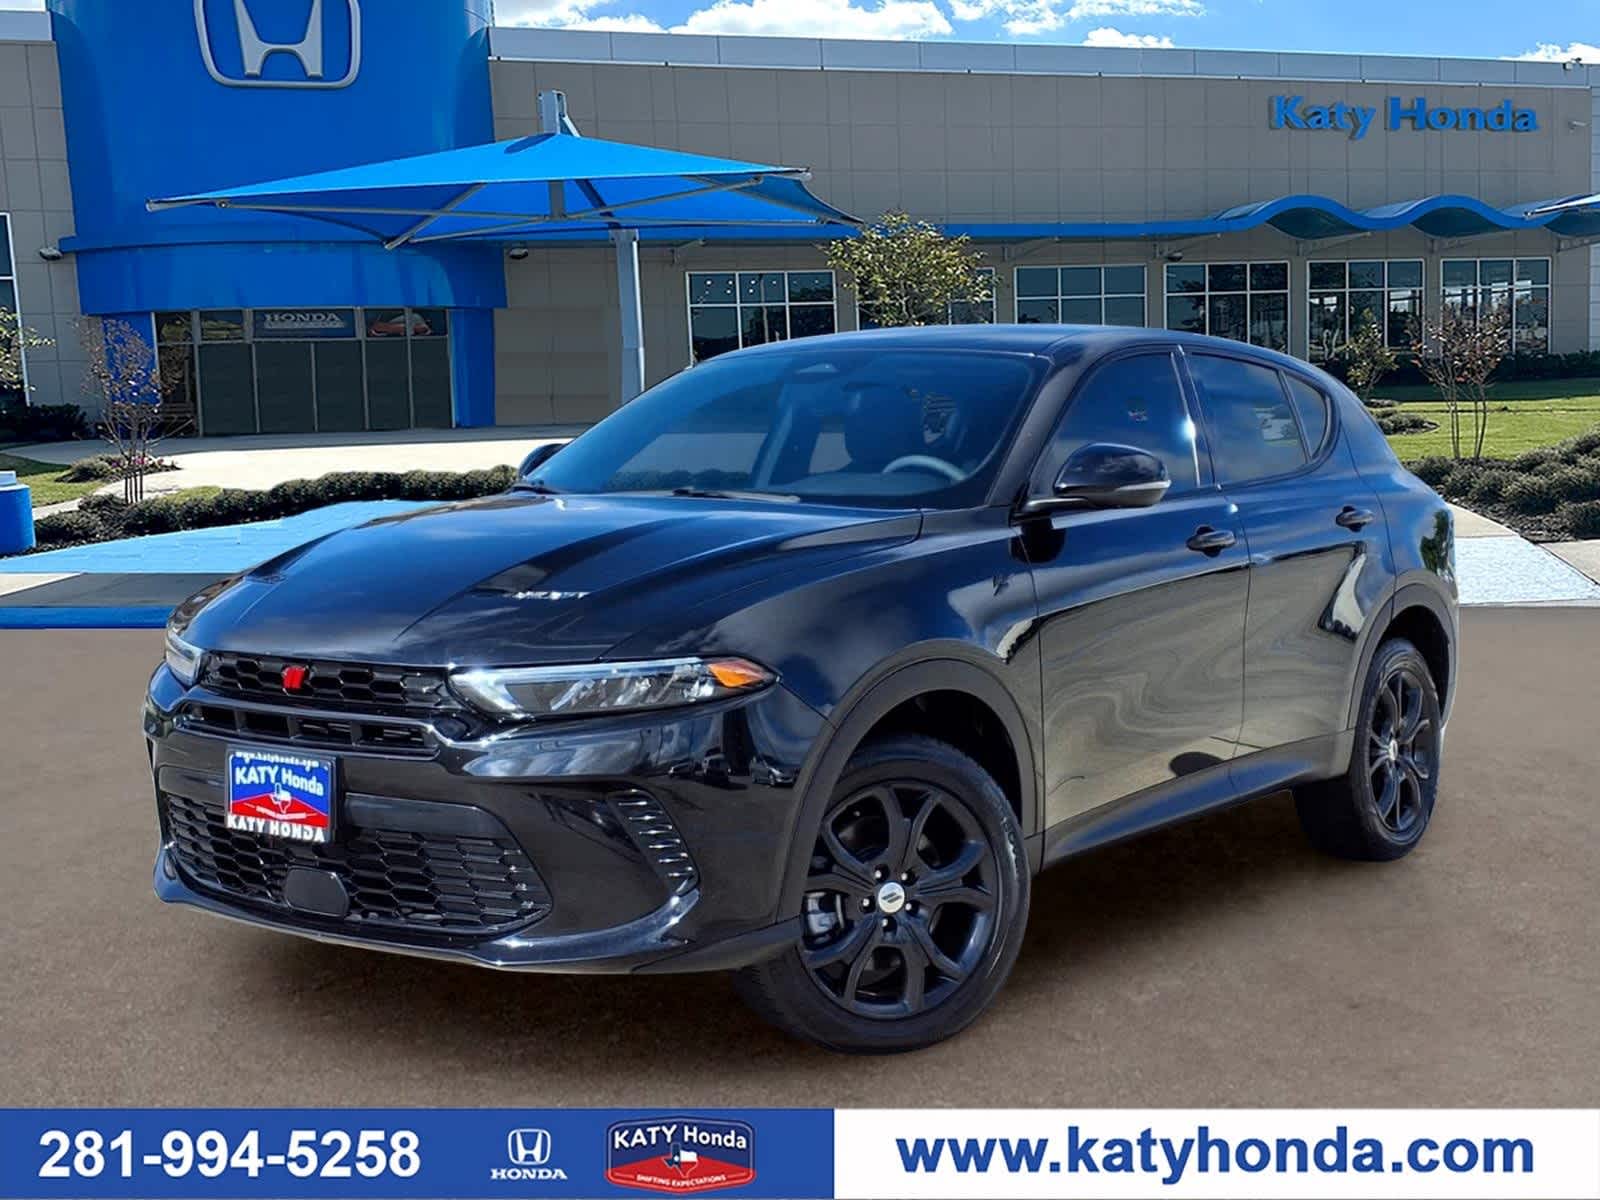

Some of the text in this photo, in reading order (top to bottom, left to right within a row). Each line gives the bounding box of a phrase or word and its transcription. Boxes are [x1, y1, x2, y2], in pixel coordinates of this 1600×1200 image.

[1271, 96, 1538, 140] Katy Honda
[264, 312, 341, 322] HONDA
[235, 765, 324, 796] KATY Honda
[227, 814, 325, 842] KATY HONDA
